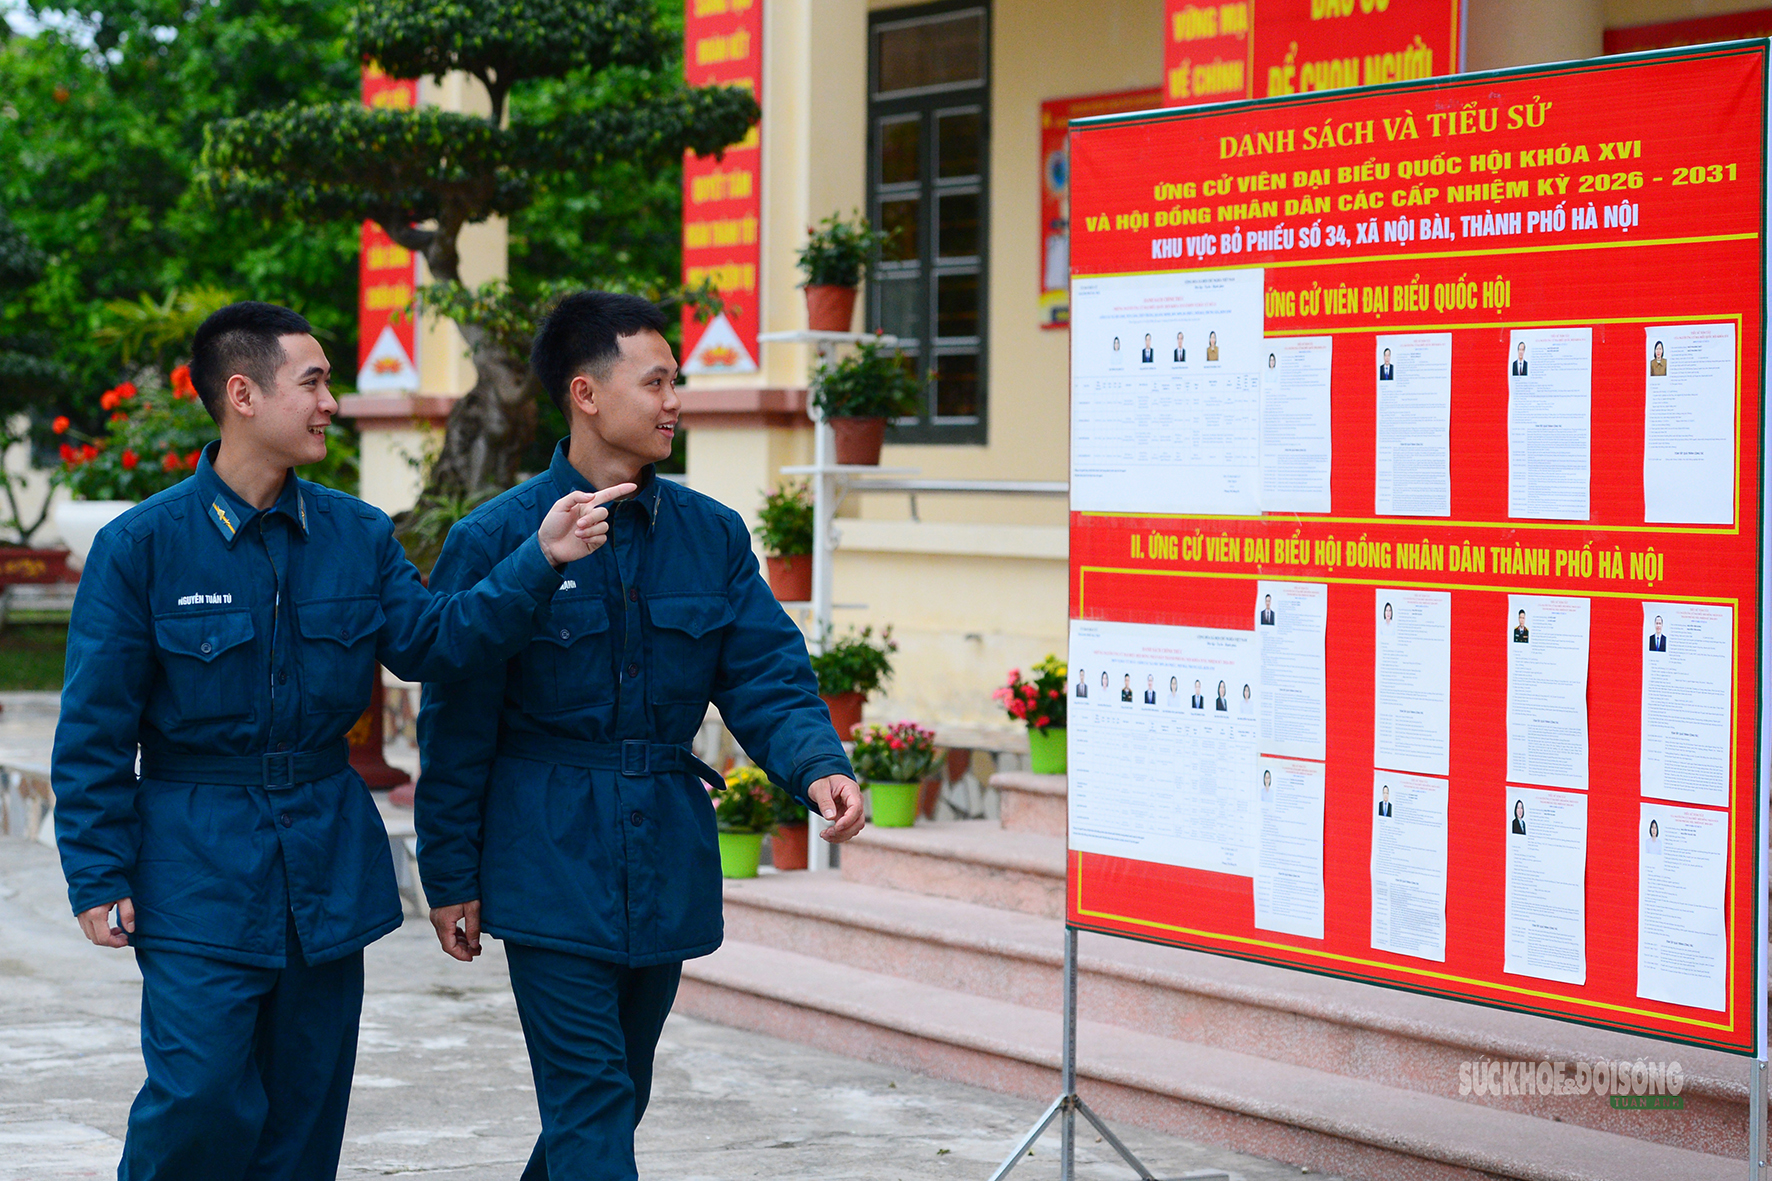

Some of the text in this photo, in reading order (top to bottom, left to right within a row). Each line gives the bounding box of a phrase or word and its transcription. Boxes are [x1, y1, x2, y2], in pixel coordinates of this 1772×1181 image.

[1220, 95, 1553, 159] DANH SÁCH VÀ TIỂU SỬ
[1086, 213, 1110, 232] VÀ
[1116, 210, 1149, 232] HỘI
[1154, 205, 1211, 228] ĐỒNG
[1217, 199, 1278, 222] NHÂN
[1285, 195, 1331, 216] DÂN
[1338, 190, 1383, 212] CÁC
[1391, 185, 1439, 207] CẤP
[1447, 180, 1528, 203] NHIỆM
[1538, 174, 1571, 196] KỲ
[1578, 171, 1643, 193] 2026
[1672, 163, 1737, 186] 2031
[1154, 140, 1641, 201] ỨNG CỬ VIÊN ĐẠI BIỂU QUỐC HỘI KHÓA XVI
[1152, 199, 1638, 260] KHU VỰC BỎ PHIẾU SỐ 34, XÃ NỘI BÀI, THÀNH PHỐ HÀ NỘI
[1265, 287, 1295, 317] ỨNG
[1300, 281, 1321, 316] CỬ
[1324, 283, 1358, 314] VIÊN
[1363, 286, 1388, 318] ĐẠI
[1394, 273, 1429, 311] BIỂU
[1434, 273, 1477, 312] QUỐC
[1483, 274, 1510, 314] HỘI
[1131, 528, 1663, 587] II. ỨNG CỬ VIÊN ĐẠI BIỂU HỘI ĐỒNG NHÂN DÂN THÀNH PHỐ HÀ NỘI
[178, 592, 232, 605] NGUYỄN TUẤN TÚ
